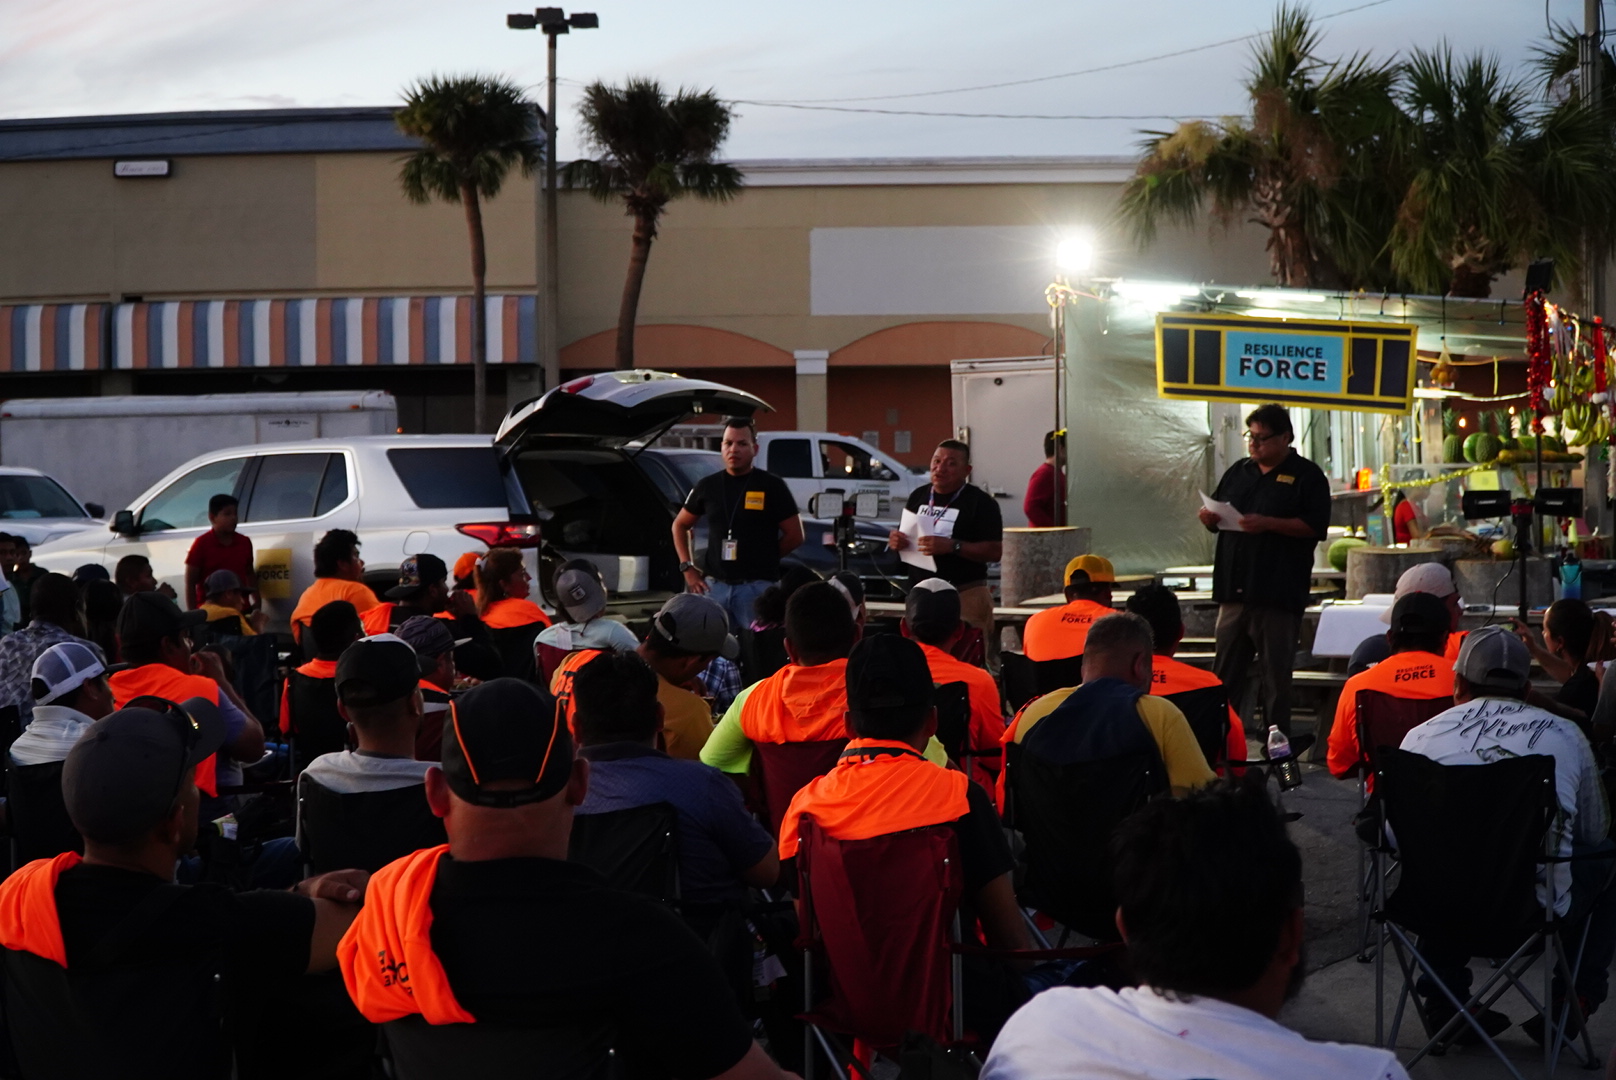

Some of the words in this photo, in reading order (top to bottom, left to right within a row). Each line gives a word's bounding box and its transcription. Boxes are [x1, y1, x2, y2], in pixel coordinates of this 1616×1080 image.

[1244, 343, 1323, 359] RESILIENCE
[1239, 357, 1329, 382] FORCE
[1061, 615, 1092, 623] FORCE
[1395, 669, 1436, 683] FORCE
